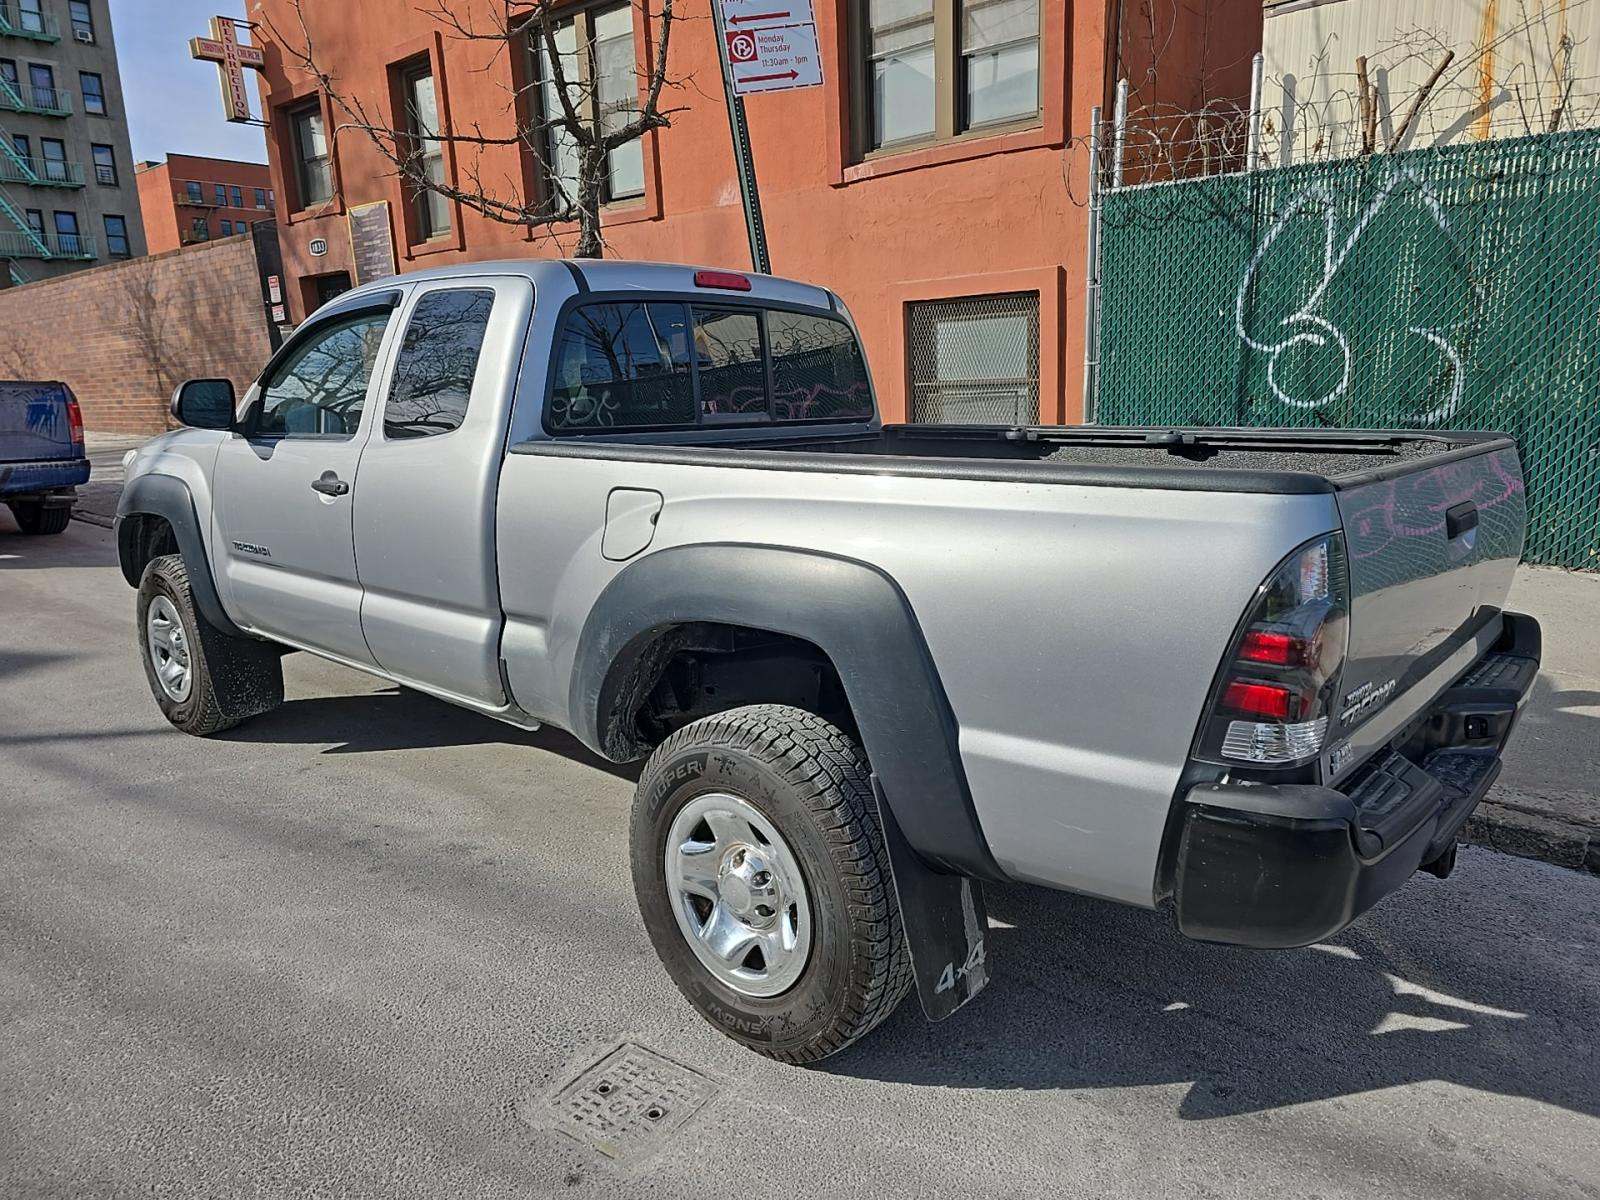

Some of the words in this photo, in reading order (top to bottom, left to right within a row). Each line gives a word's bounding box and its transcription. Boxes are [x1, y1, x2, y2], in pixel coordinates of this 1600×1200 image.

[757, 34, 784, 43] Monday
[237, 48, 260, 60] CHURCH
[759, 44, 791, 54] Thursday
[761, 57, 789, 67] 11:30am
[794, 56, 808, 65] 1pm
[221, 20, 246, 116] RESURRECTION
